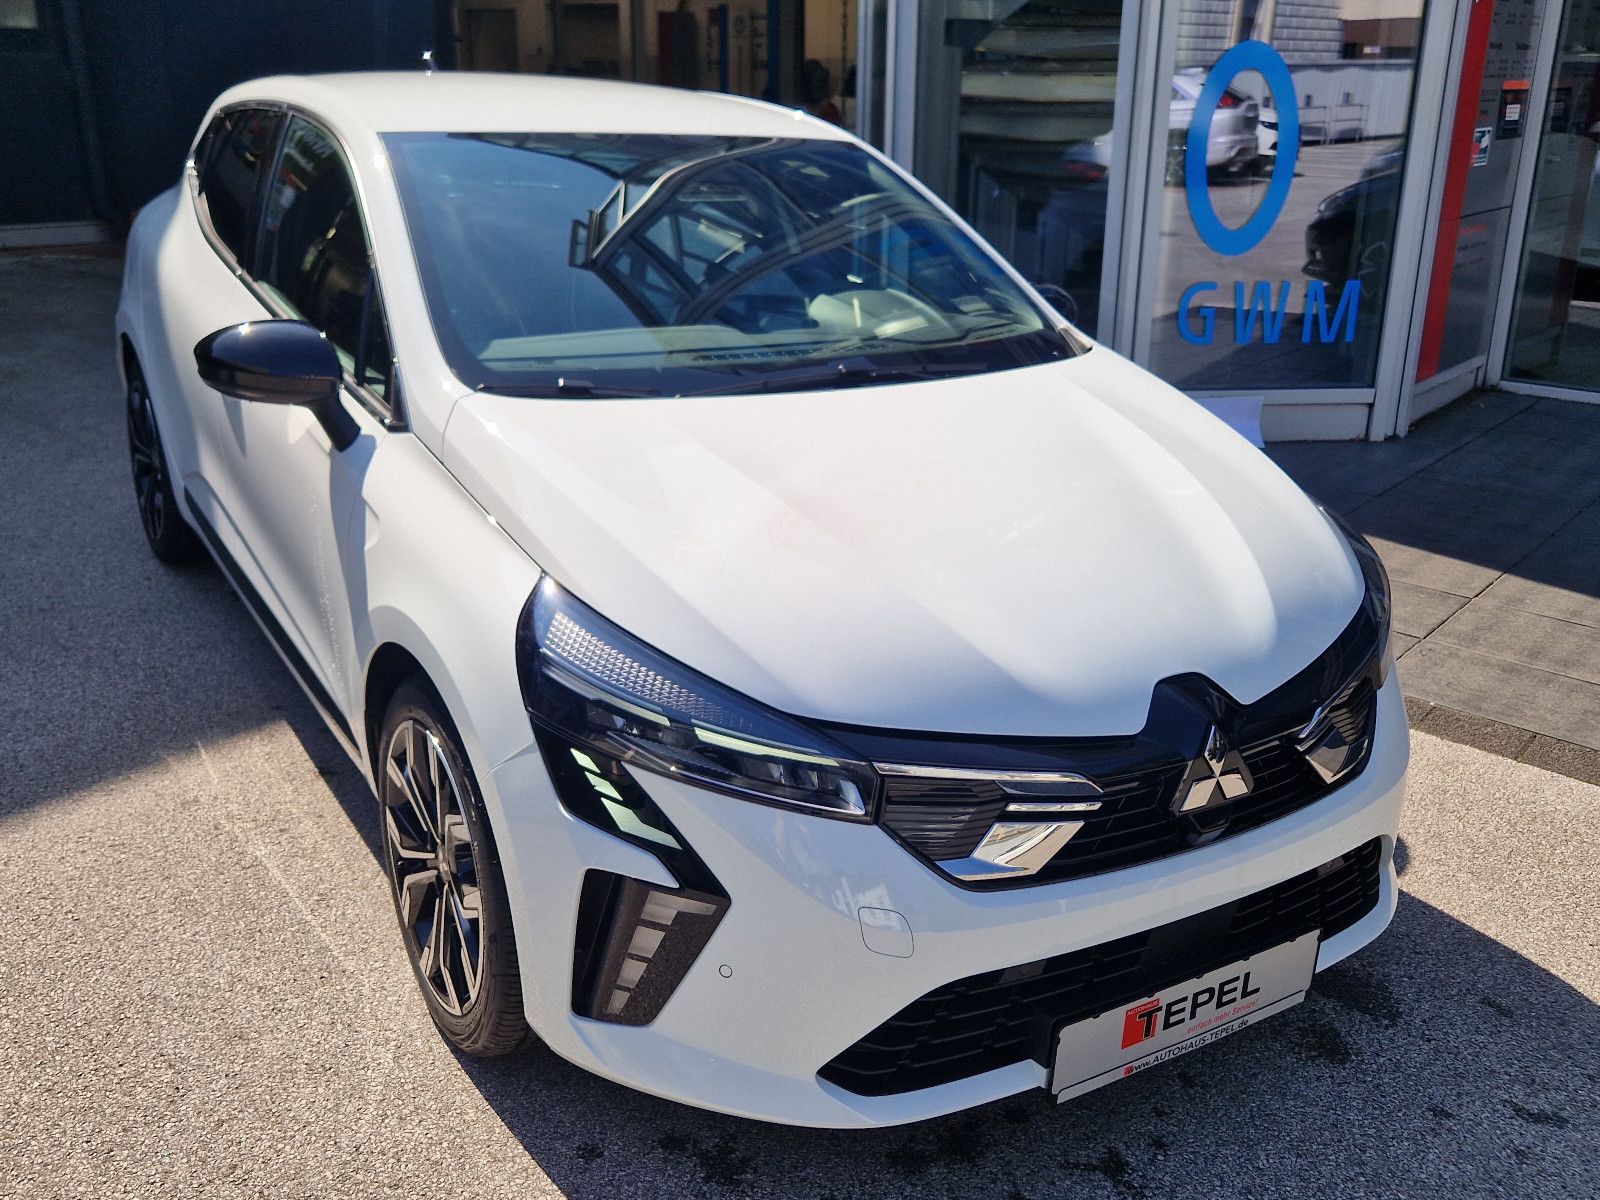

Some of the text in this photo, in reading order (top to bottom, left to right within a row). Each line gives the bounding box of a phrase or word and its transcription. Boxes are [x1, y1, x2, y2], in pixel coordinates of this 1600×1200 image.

[1176, 279, 1362, 346] GWM
[1137, 971, 1261, 1039] TEPEL
[1213, 1011, 1231, 1024] mehr
[1127, 1018, 1249, 1073] www.AUTOHAUS-TEPEL.de
